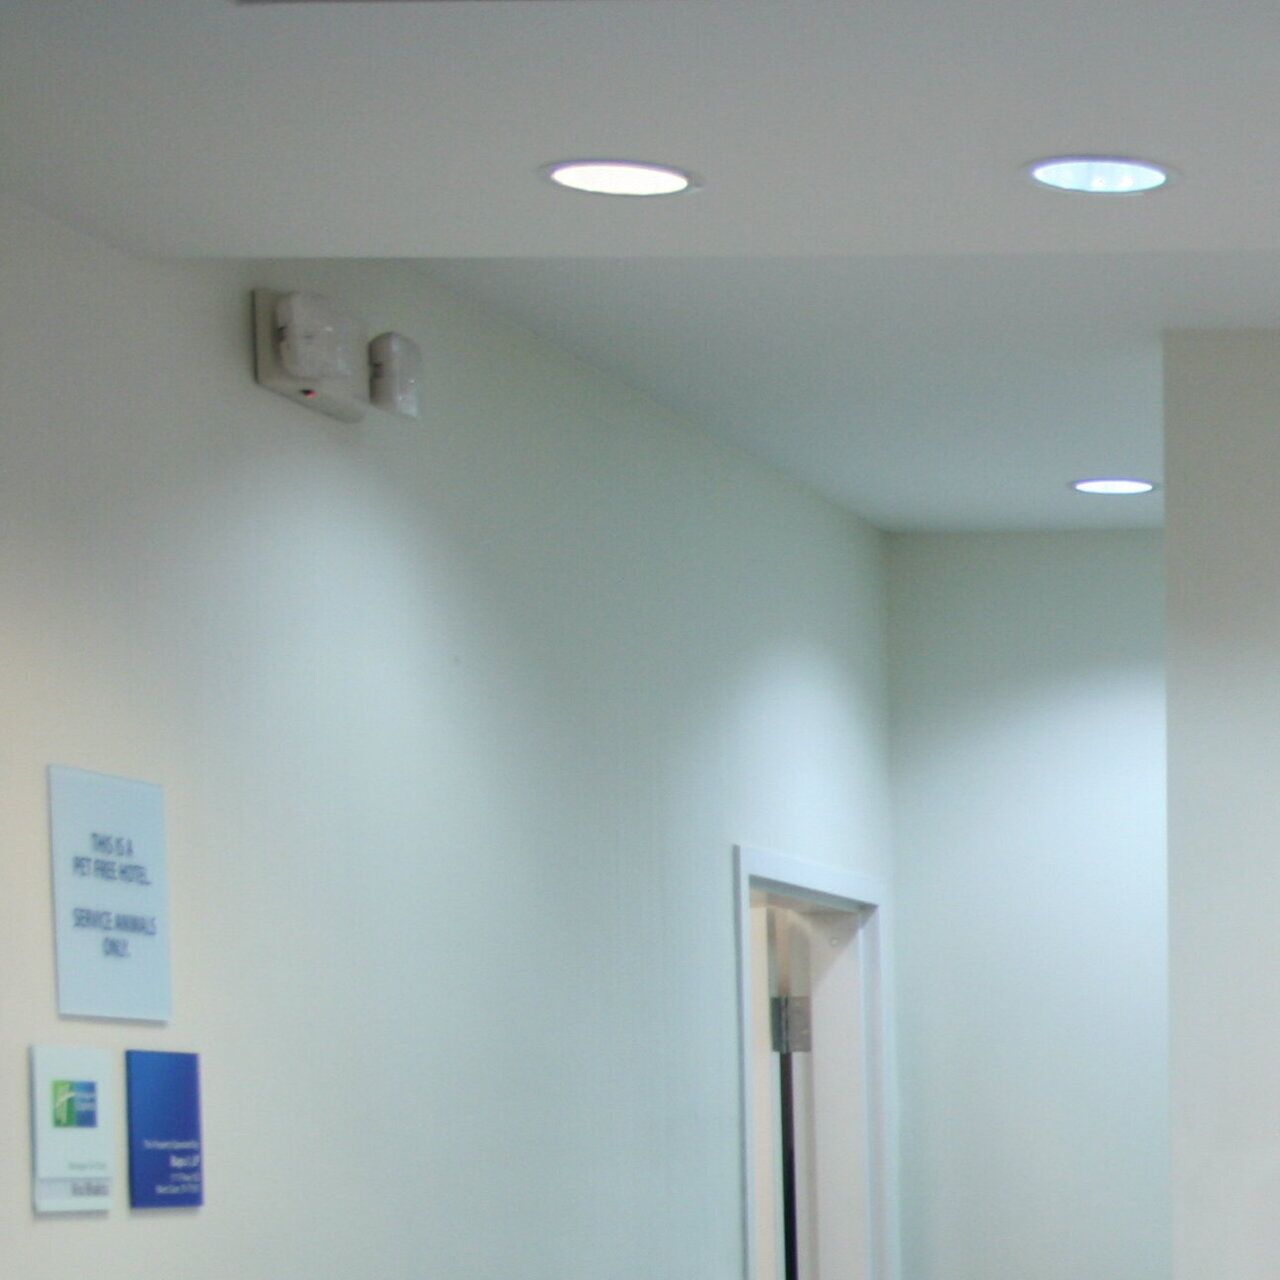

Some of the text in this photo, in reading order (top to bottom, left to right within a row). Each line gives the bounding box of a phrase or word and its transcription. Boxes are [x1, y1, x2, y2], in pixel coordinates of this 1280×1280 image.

[73, 856, 92, 877] PET
[94, 859, 117, 880] FREE
[73, 907, 113, 931] SERVICE
